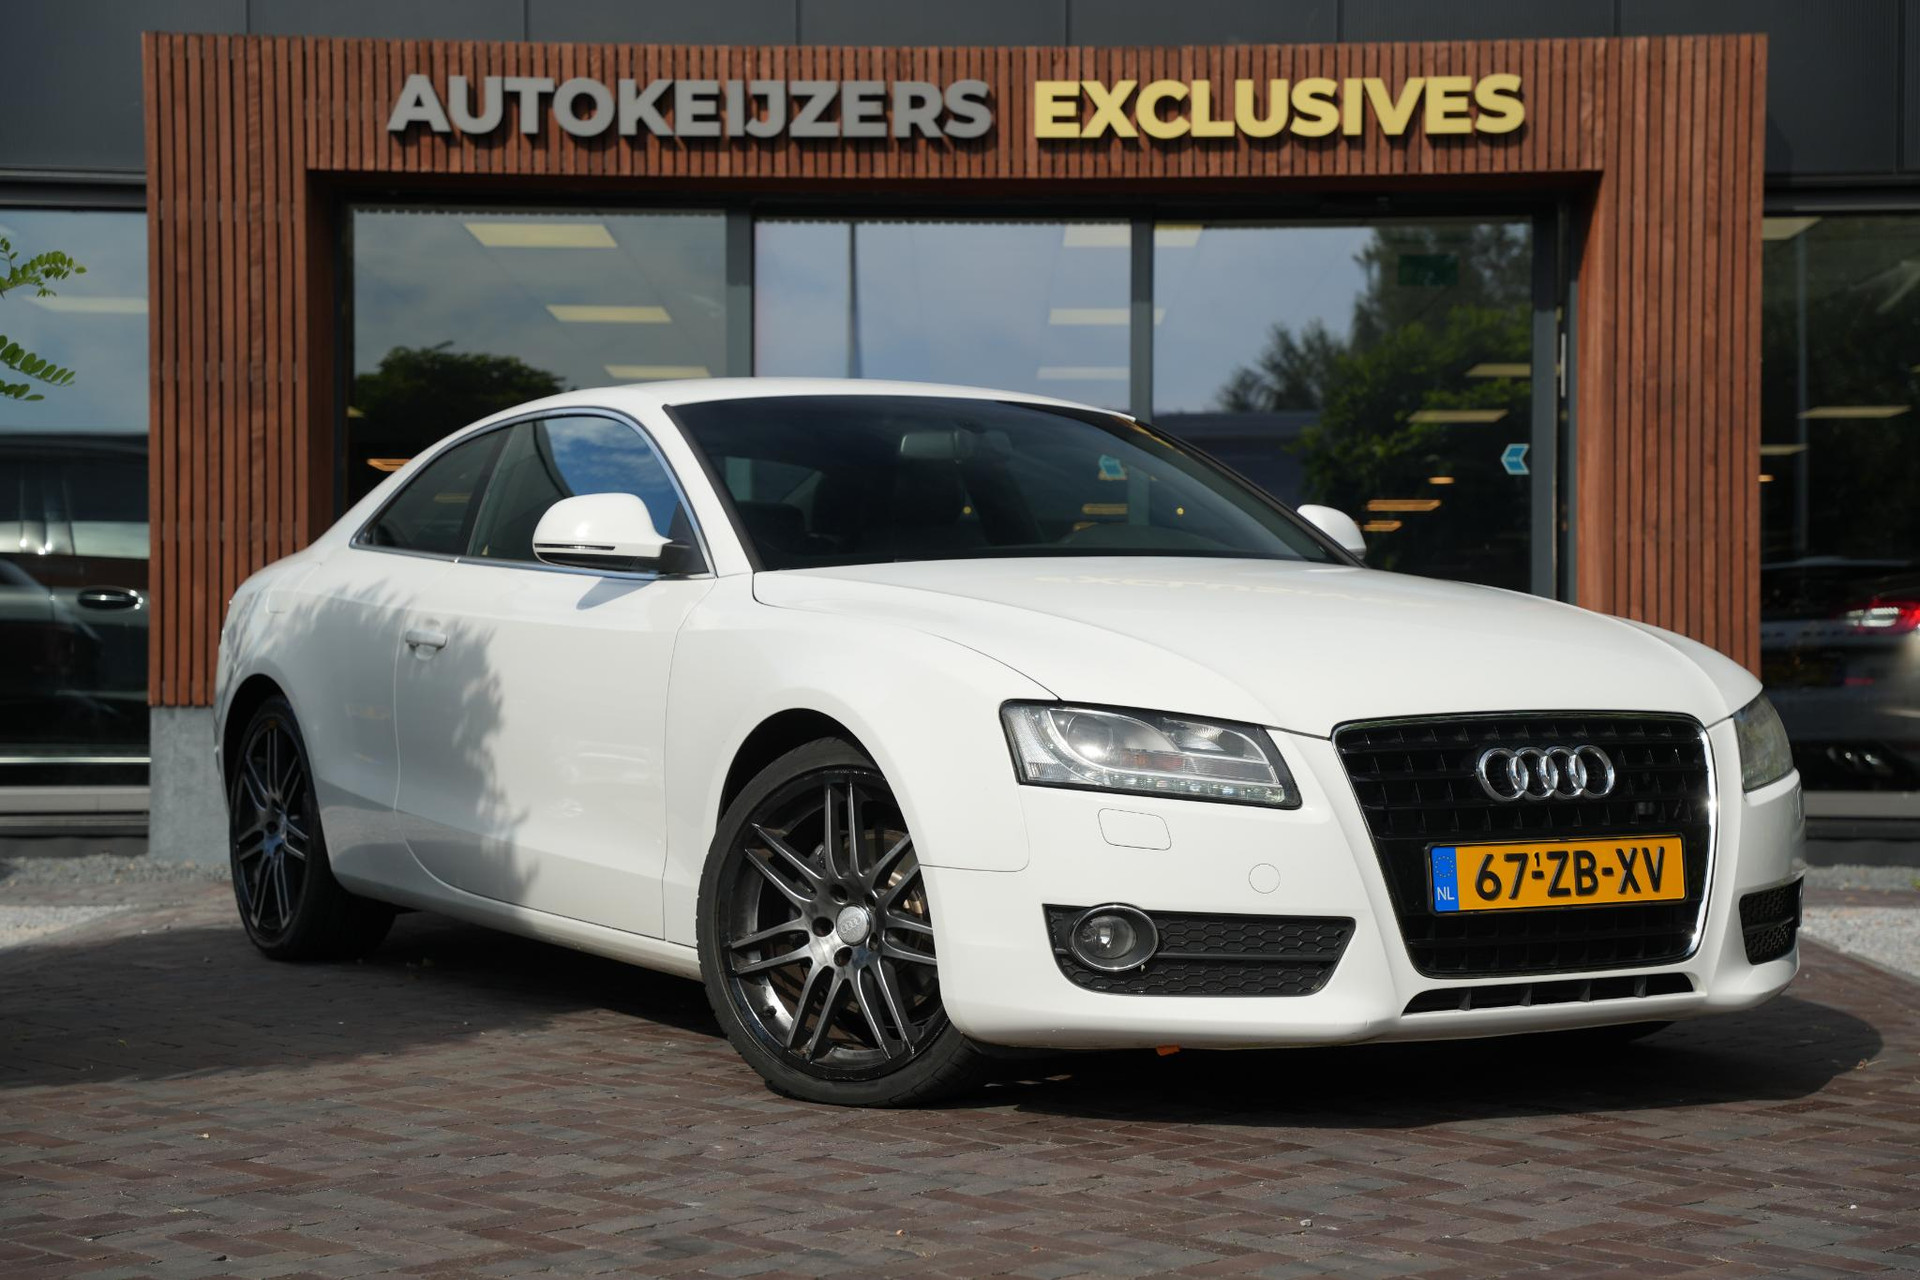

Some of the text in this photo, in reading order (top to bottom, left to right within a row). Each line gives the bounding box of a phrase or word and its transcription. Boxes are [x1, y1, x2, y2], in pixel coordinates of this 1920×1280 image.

[386, 73, 1526, 139] AUTOKEIJZERS EXCLUSIVES
[1436, 886, 1455, 901] NL
